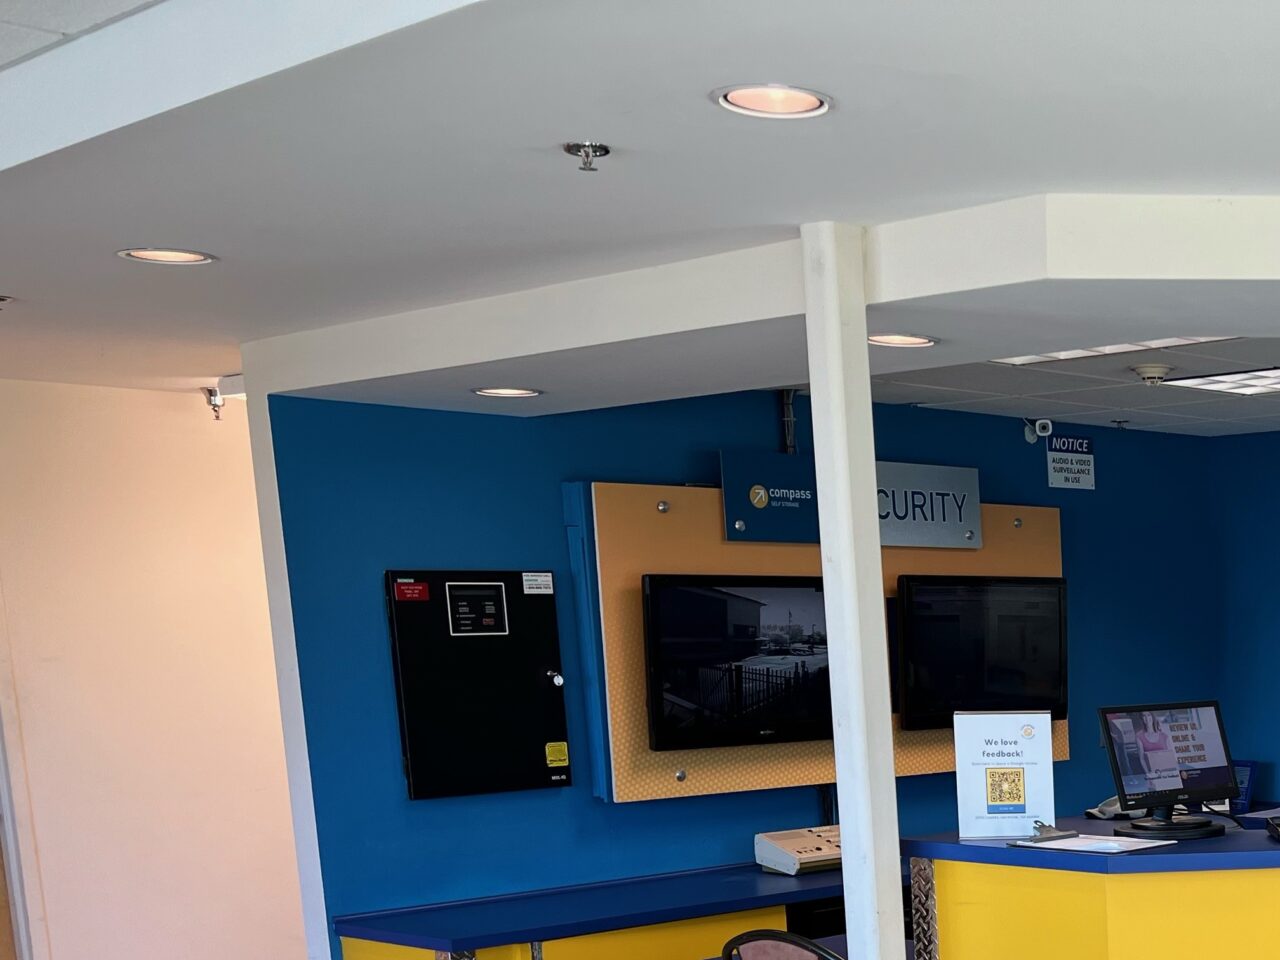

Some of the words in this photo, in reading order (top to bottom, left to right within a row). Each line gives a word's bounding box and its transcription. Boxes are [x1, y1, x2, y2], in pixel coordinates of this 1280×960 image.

[1052, 437, 1089, 451] NOTICE
[1052, 457, 1070, 465] AUDIO
[1052, 466, 1091, 475] SURVEILLANCE
[769, 487, 812, 501] compass
[877, 488, 967, 523] CURITY
[1168, 723, 1189, 732] REVIEW
[1000, 738, 1019, 746] love
[981, 750, 1024, 758] feedback!
[1176, 754, 1207, 764] EXPERIENCE
